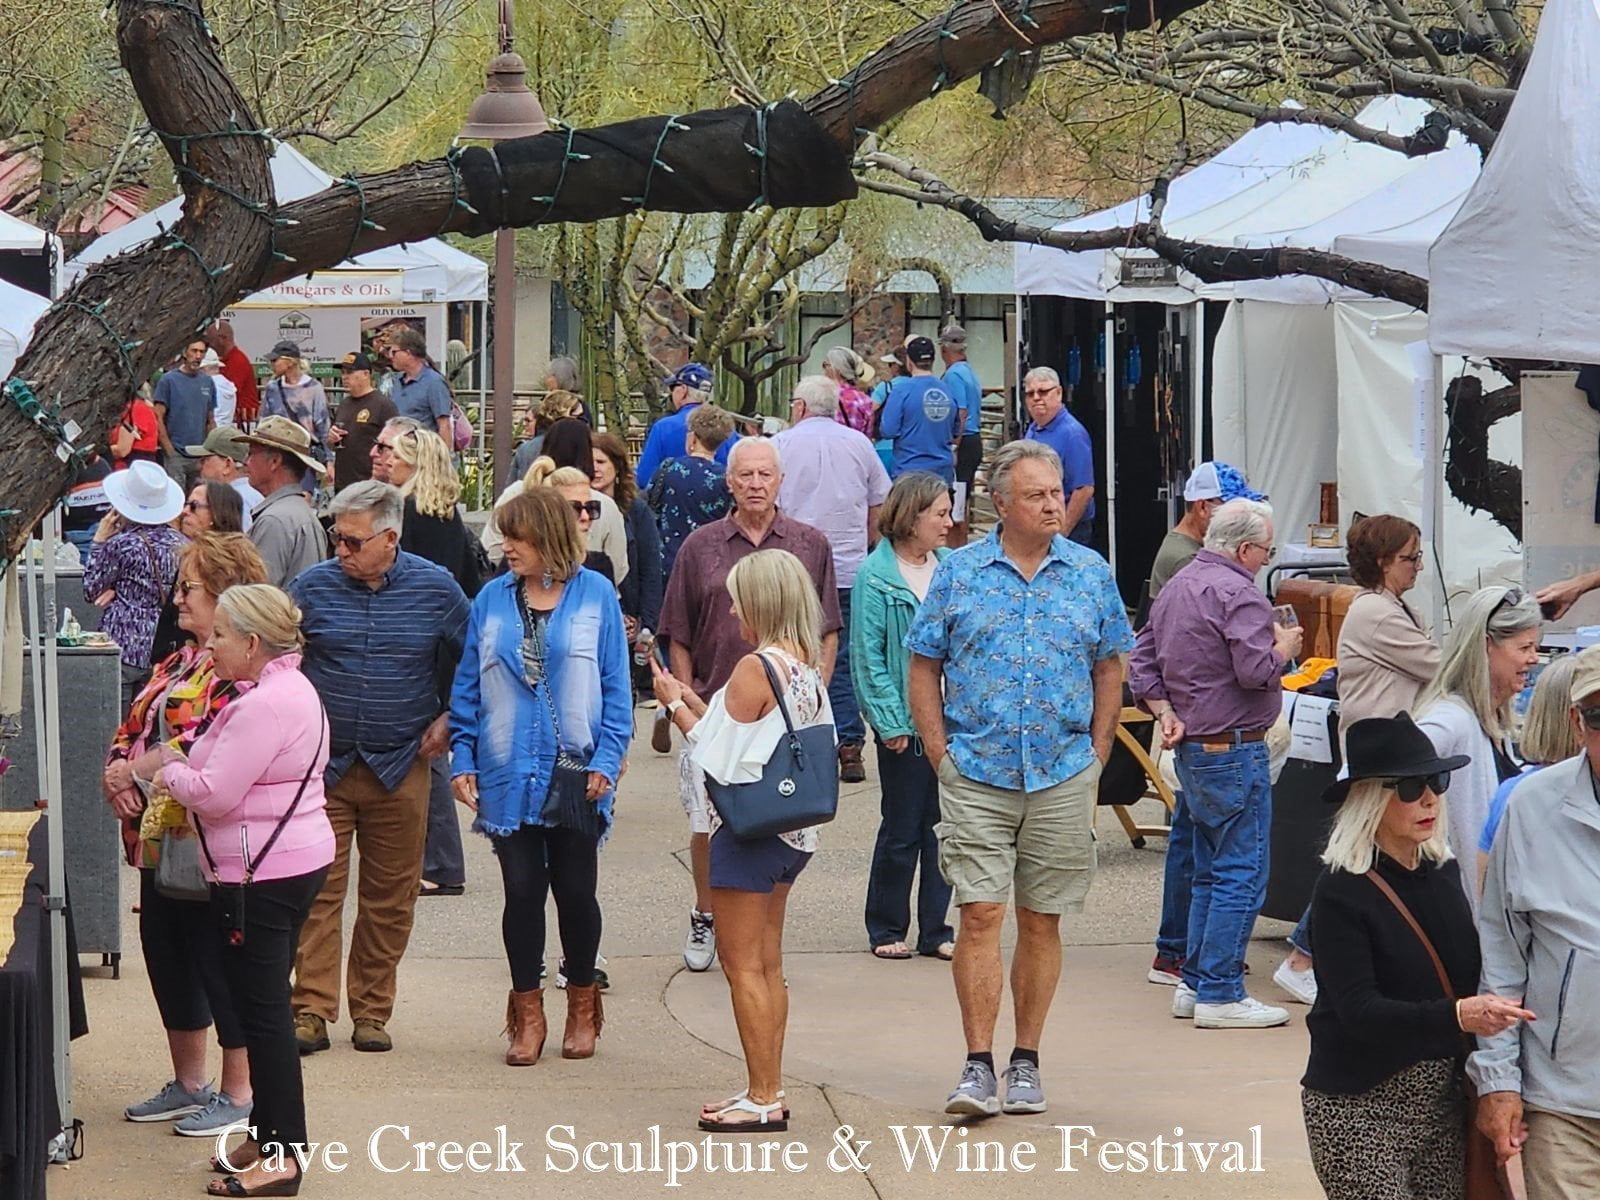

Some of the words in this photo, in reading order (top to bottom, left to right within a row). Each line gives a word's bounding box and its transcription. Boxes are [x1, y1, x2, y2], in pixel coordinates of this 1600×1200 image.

[271, 284, 336, 298] Vinegars
[341, 284, 353, 296] &
[359, 284, 391, 296] Oils
[371, 308, 394, 316] OLIVE
[397, 308, 416, 316] OILS
